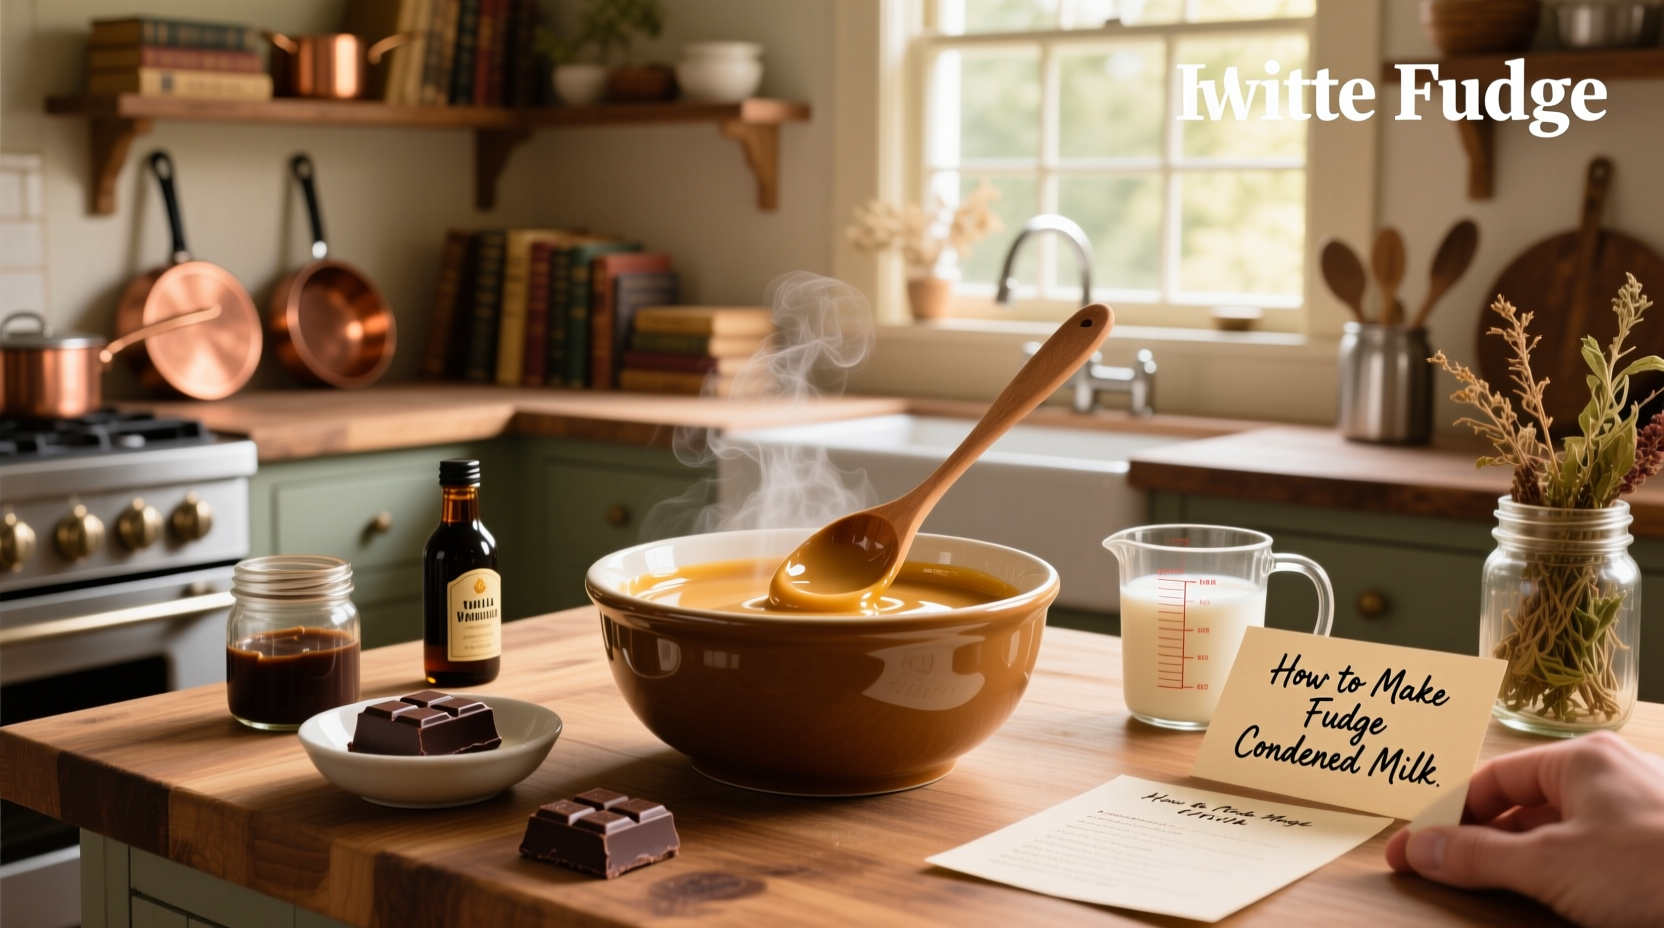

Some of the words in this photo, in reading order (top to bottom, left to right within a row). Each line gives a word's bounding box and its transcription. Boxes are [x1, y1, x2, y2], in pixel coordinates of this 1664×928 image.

[1270, 653, 1330, 688] How
[1337, 665, 1366, 693] to
[1370, 667, 1450, 706] Make
[1303, 697, 1387, 746] Fudge
[1234, 725, 1366, 774] Condened
[1368, 745, 1440, 787] Milk.
